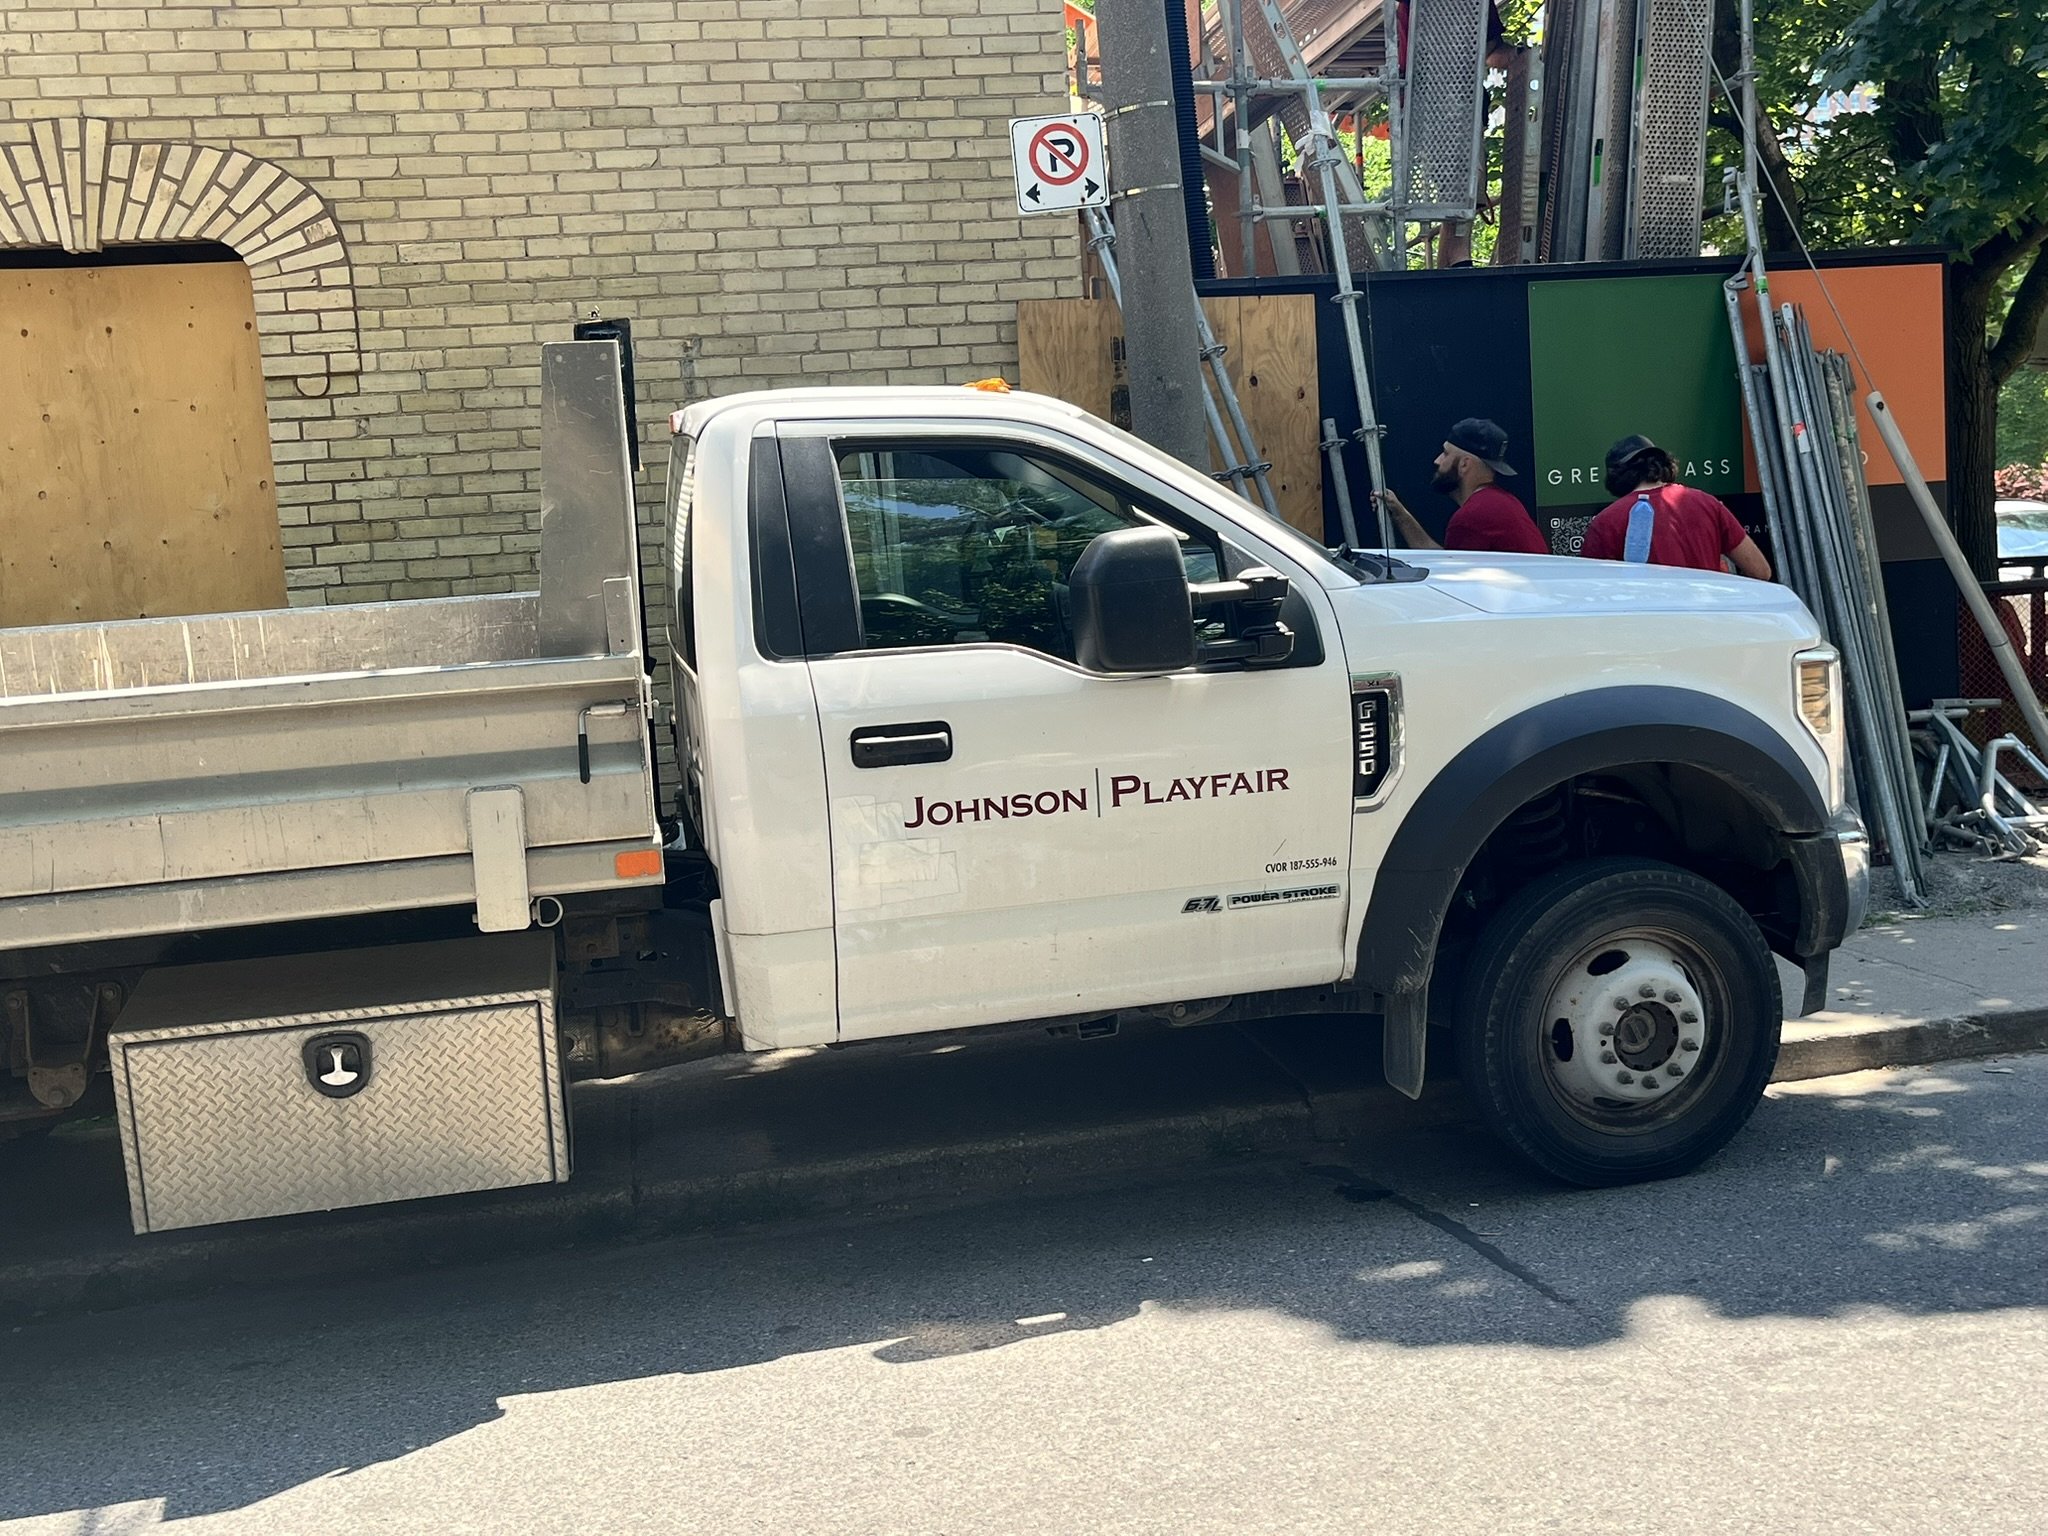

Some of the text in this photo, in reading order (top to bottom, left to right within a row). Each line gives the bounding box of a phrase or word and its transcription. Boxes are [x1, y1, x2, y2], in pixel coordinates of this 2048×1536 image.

[1358, 700, 1376, 775] F550
[904, 768, 1290, 829] JOHNSON PLAYFAIR
[1265, 857, 1337, 873] CVOR 187-555-946
[1232, 892, 1280, 905] POWER
[1282, 886, 1337, 899] STROKE
